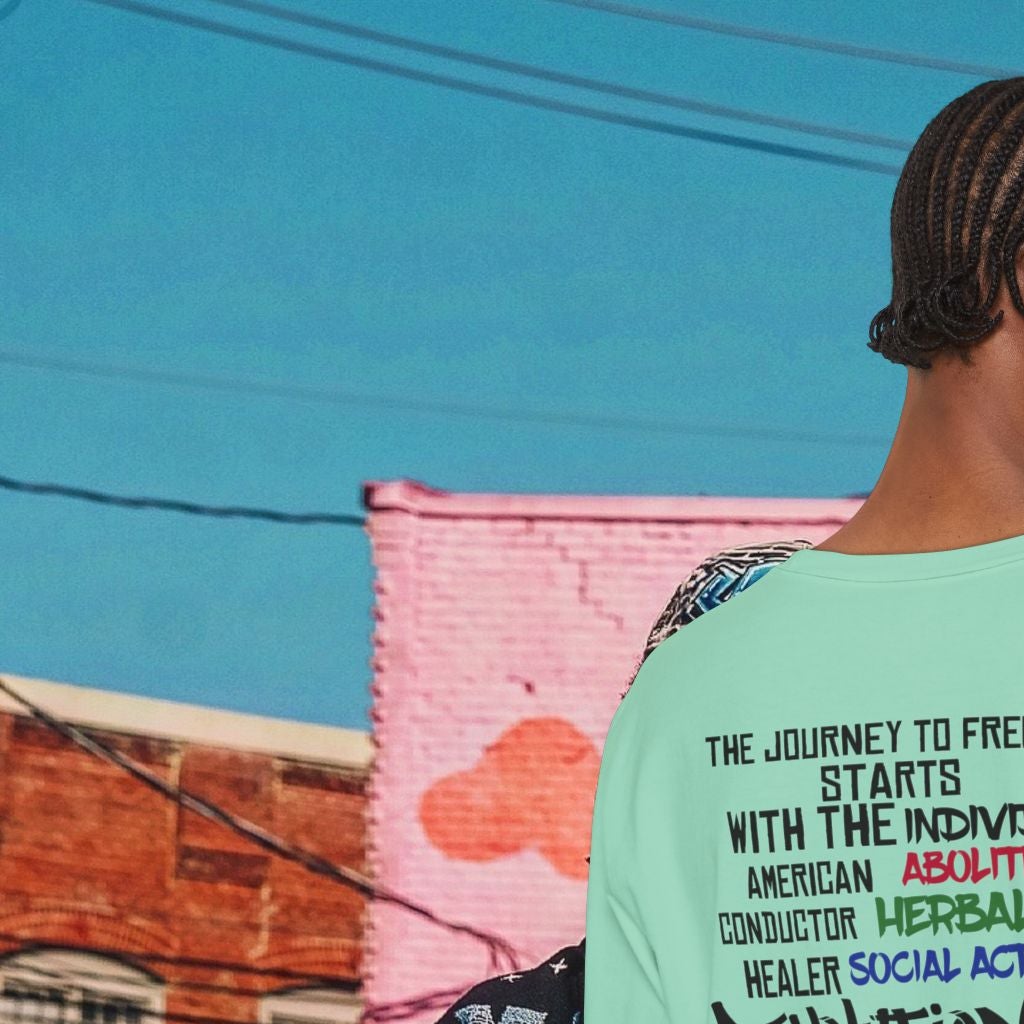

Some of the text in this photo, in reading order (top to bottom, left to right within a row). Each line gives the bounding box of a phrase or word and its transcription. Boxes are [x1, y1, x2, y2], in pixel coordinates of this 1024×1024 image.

[705, 733, 754, 766] THE
[765, 721, 901, 762] JOURNEY
[914, 718, 950, 752] TO
[821, 759, 960, 801] STARTS
[727, 808, 805, 853] WITH
[817, 803, 896, 848] THE
[749, 860, 873, 899] AMERICAN
[719, 907, 857, 945] CONDUCTOR
[744, 957, 842, 998] HEALER
[849, 948, 961, 985] SOCIAL
